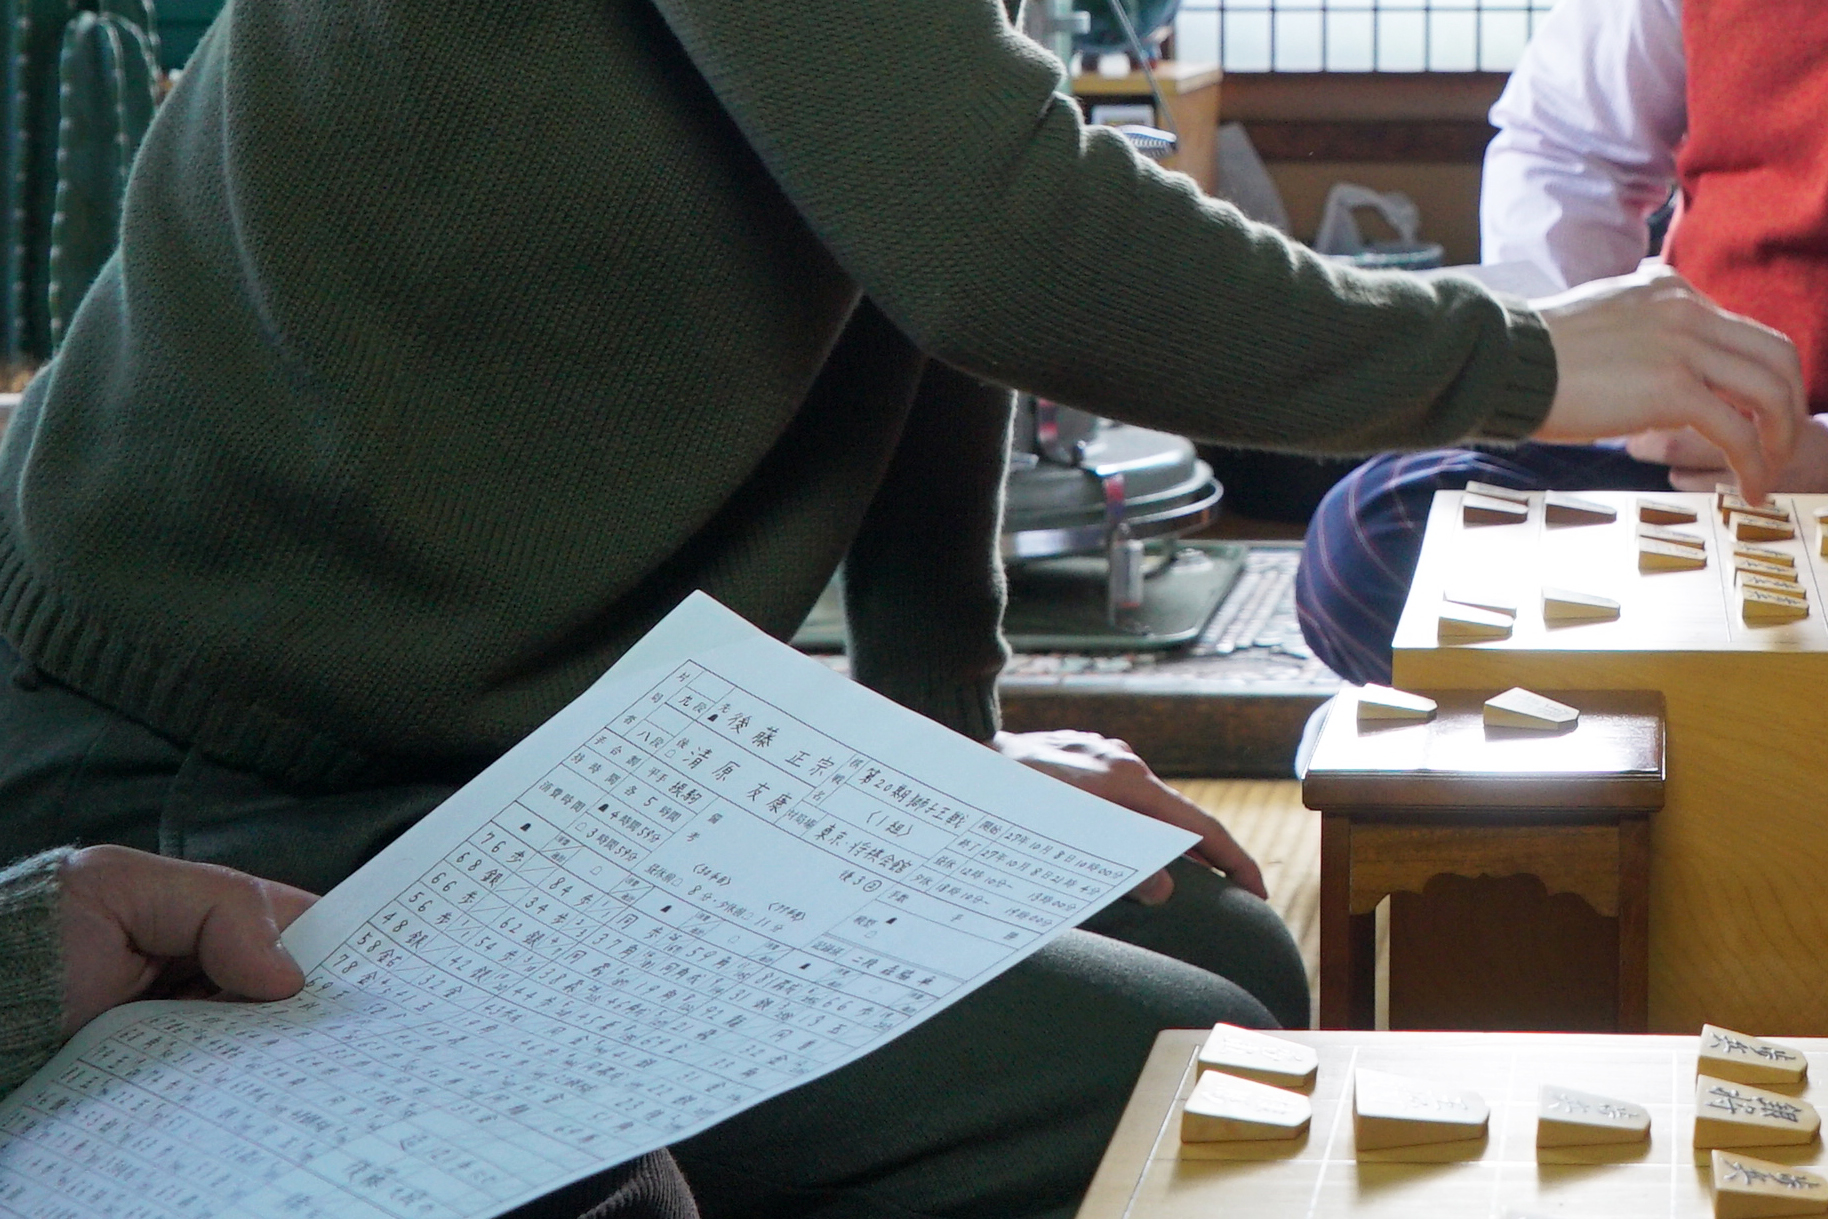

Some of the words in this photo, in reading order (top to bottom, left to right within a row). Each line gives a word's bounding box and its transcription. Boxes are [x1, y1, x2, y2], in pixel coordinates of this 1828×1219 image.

[728, 716, 779, 748] 後藤
[682, 746, 741, 782] 清原
[480, 831, 526, 863] 76歩
